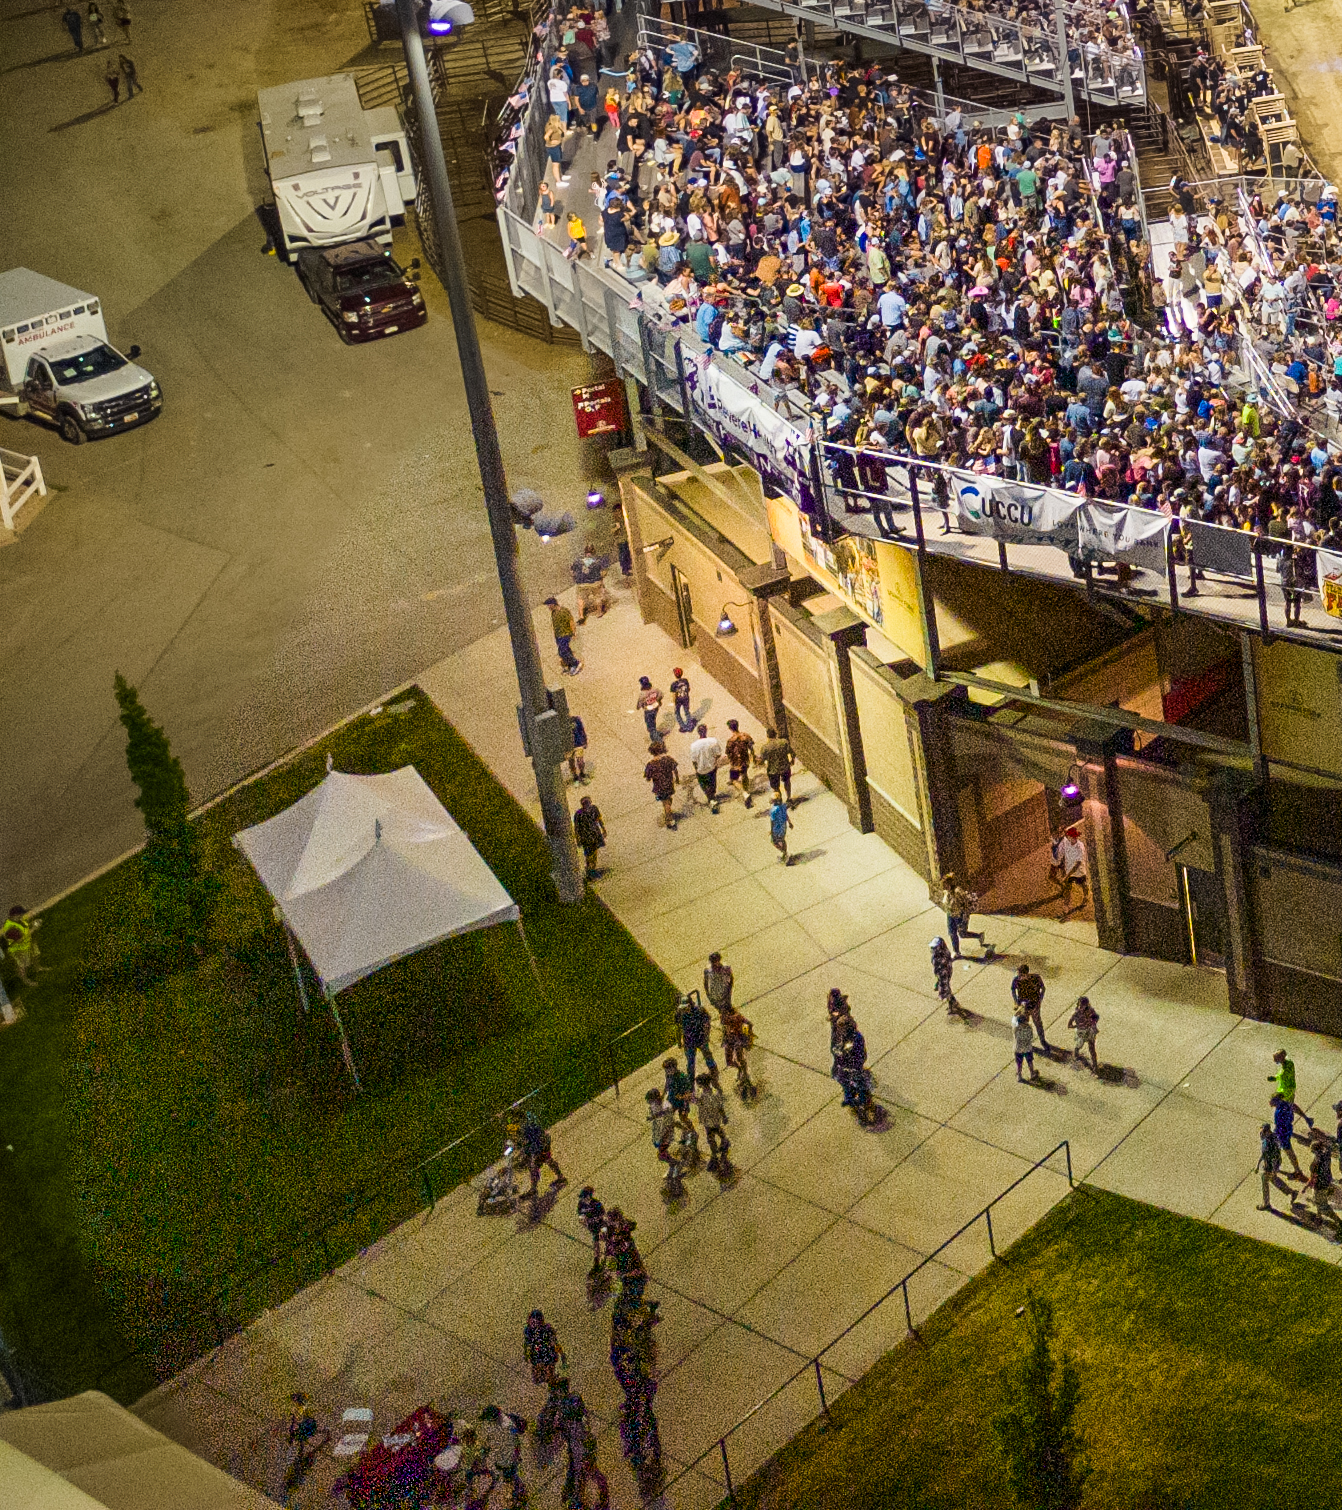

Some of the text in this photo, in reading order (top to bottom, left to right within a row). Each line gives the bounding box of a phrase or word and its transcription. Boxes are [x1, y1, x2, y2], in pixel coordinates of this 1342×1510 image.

[295, 181, 362, 199] VOLTAGE
[18, 321, 76, 346] AMBULANCE
[981, 496, 1033, 527] UCCU
